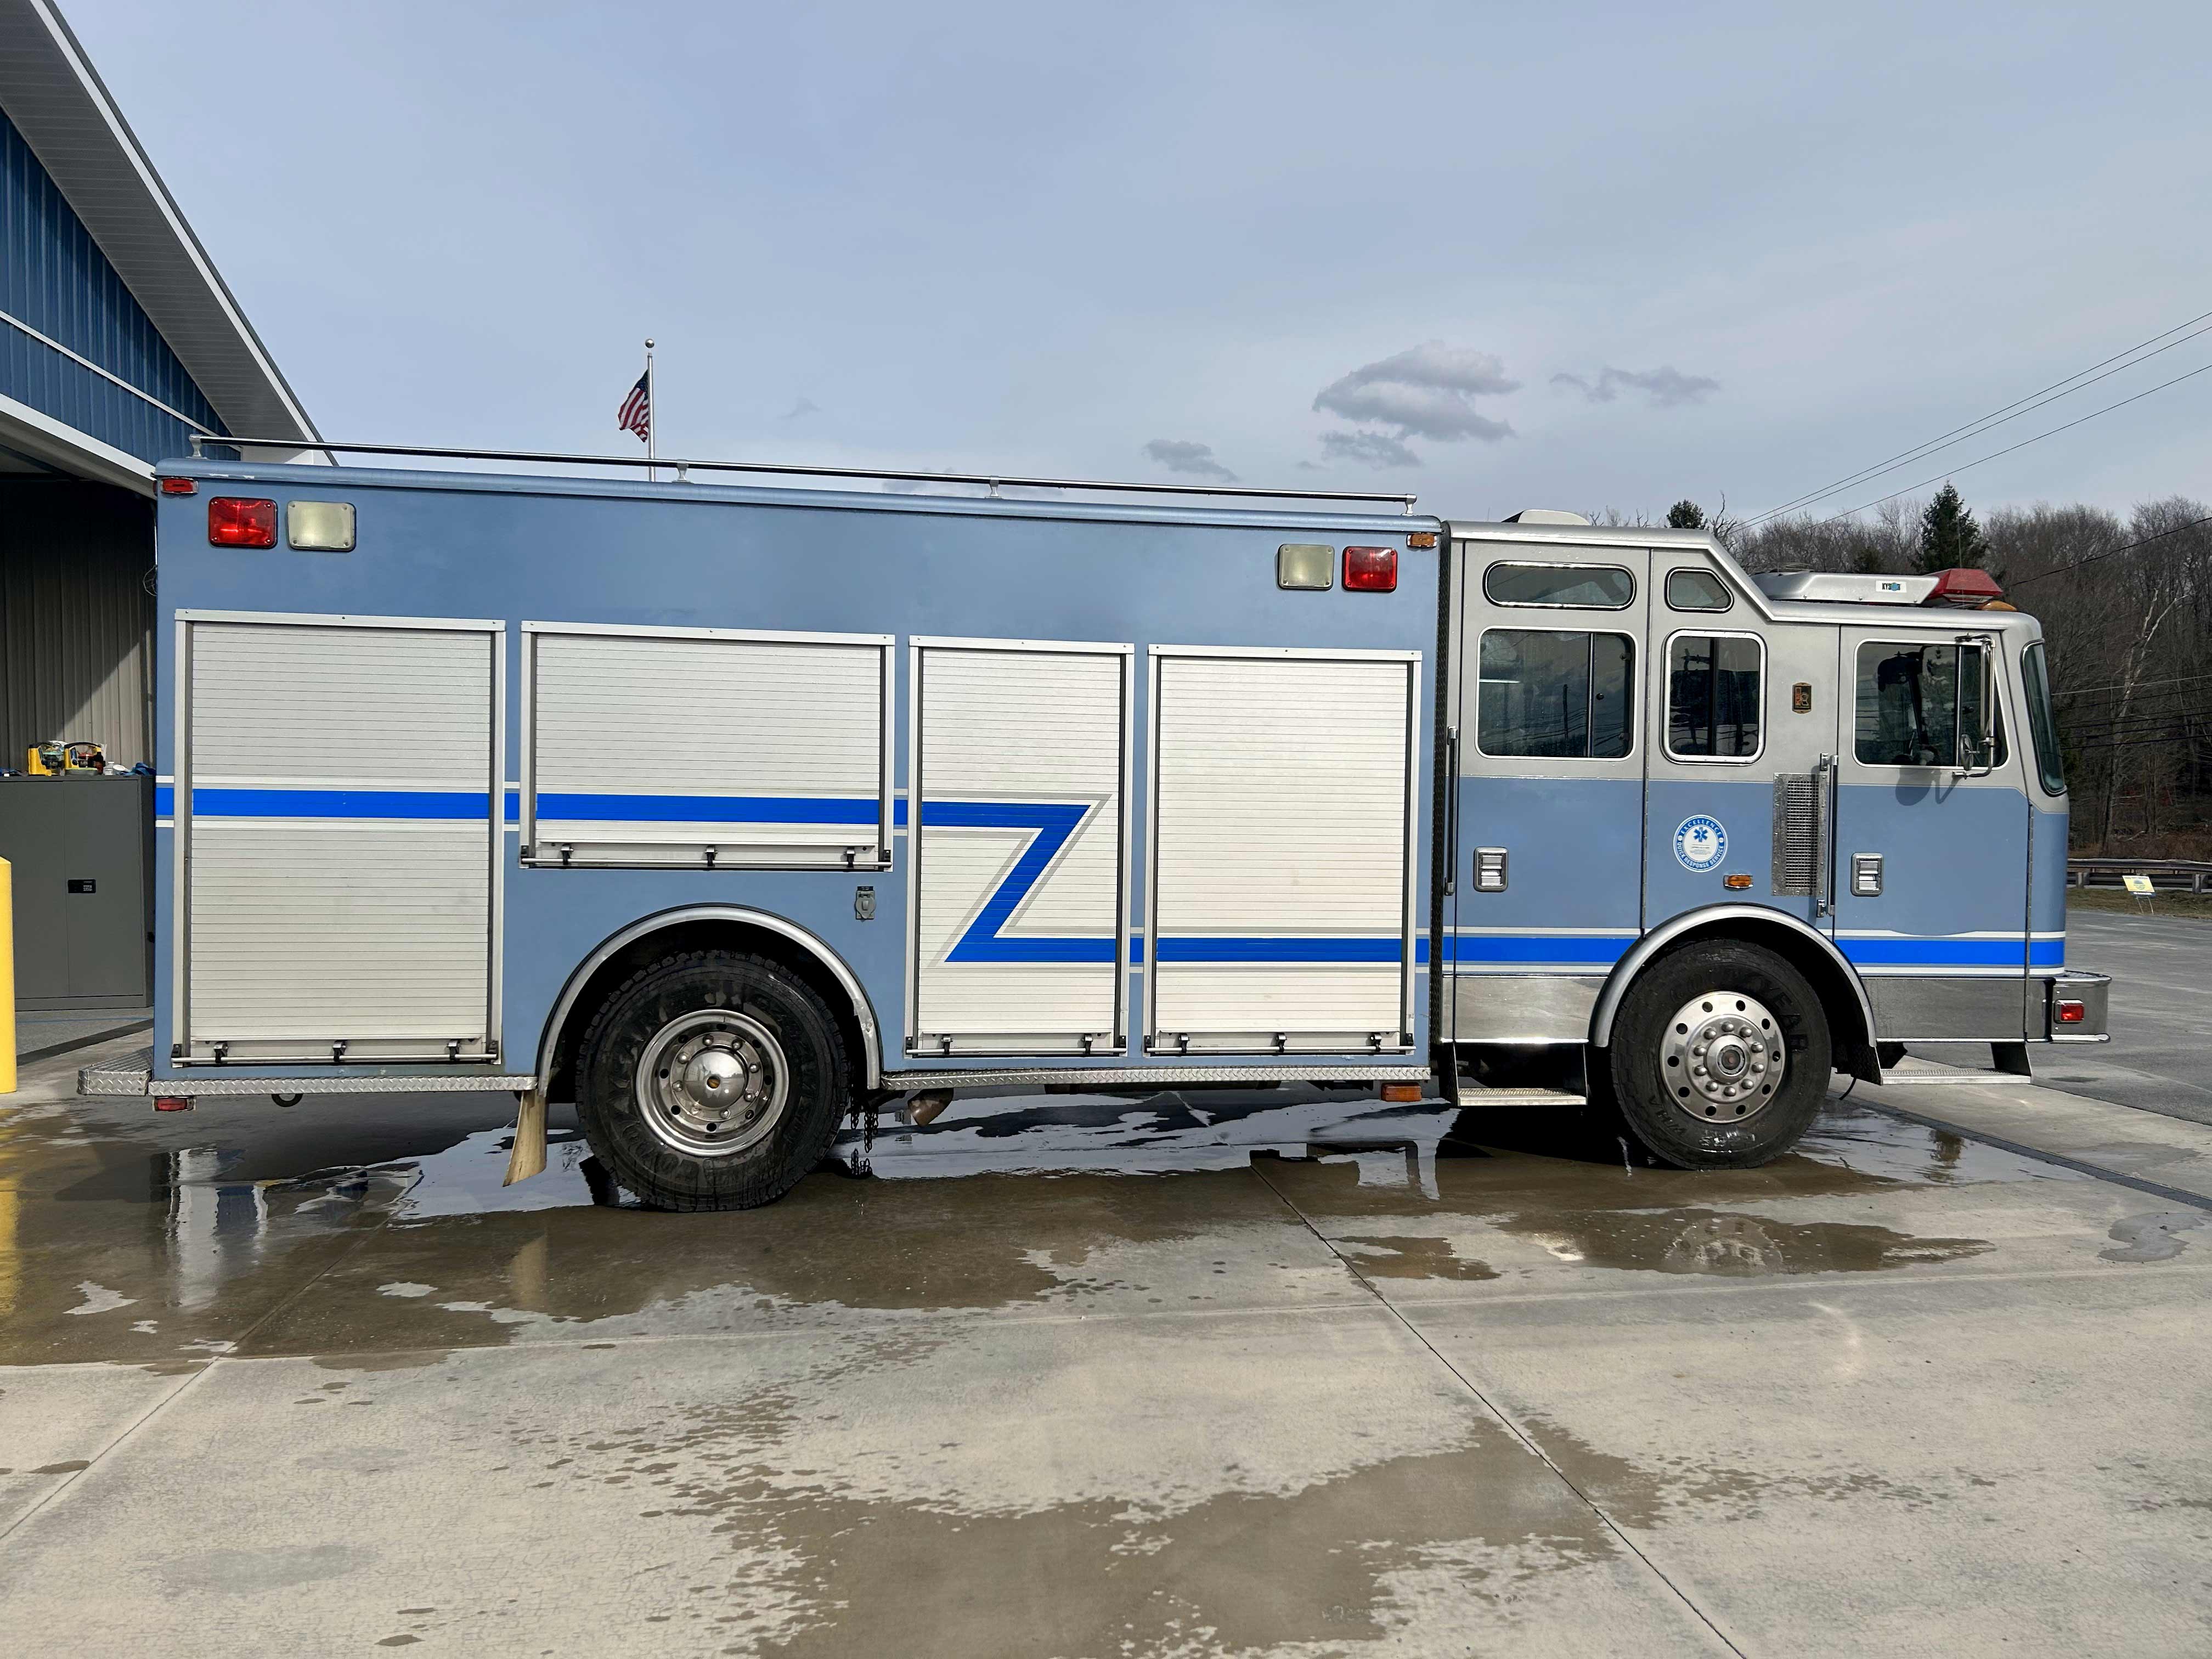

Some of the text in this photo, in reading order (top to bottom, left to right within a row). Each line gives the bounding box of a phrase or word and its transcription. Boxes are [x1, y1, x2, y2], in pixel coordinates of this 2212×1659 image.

[1680, 819, 1722, 834] EXCELLENCE
[1677, 842, 1686, 858] QUICK
[1684, 857, 1709, 868] RESPONSE
[1709, 845, 1724, 865] SERVICE
